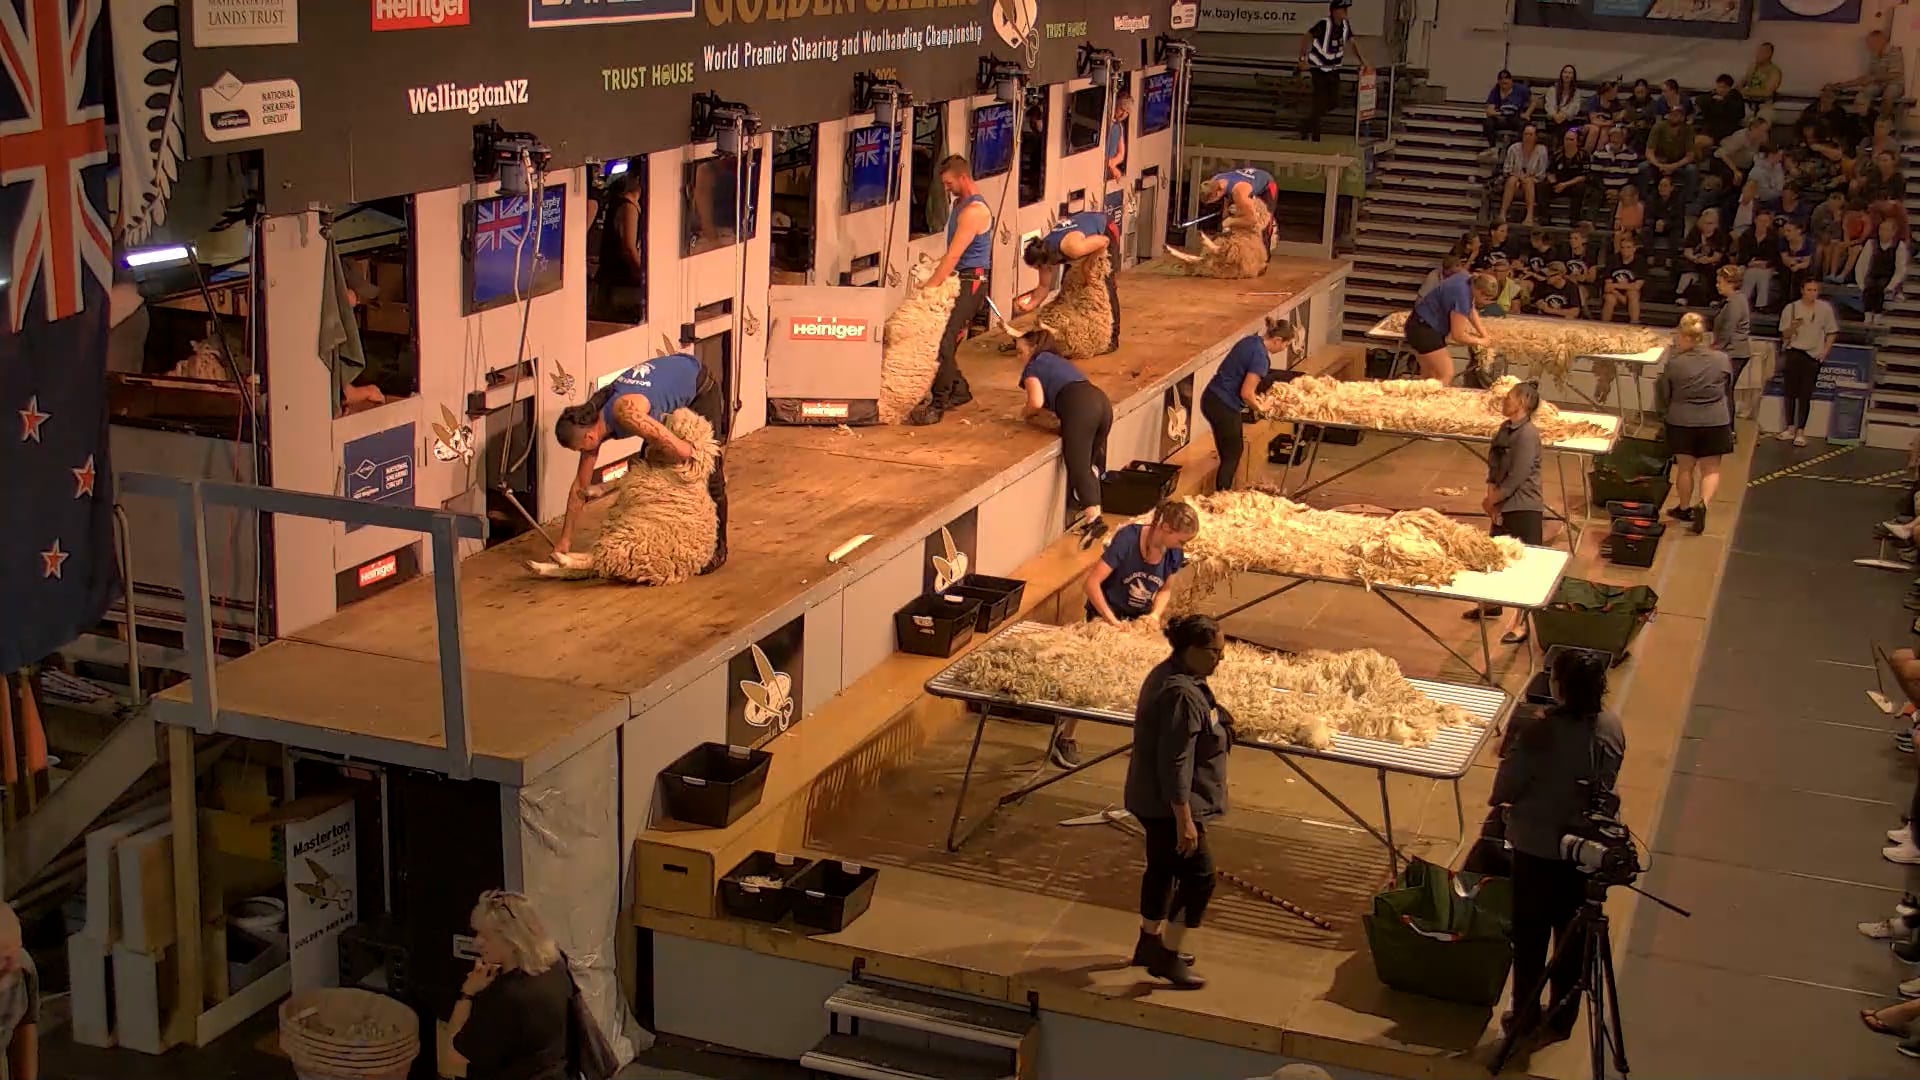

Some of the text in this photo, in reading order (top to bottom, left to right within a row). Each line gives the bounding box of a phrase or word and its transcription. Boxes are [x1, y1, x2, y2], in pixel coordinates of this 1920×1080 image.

[208, 9, 285, 25] LANDS TRUST
[703, 21, 982, 72] World Premier Shearing and Woolhandling Championship
[602, 62, 694, 91] TRUST HOUSE
[408, 79, 529, 114] WellingtonNZ
[793, 316, 865, 339] Heiniger
[293, 821, 351, 857] Masterton
